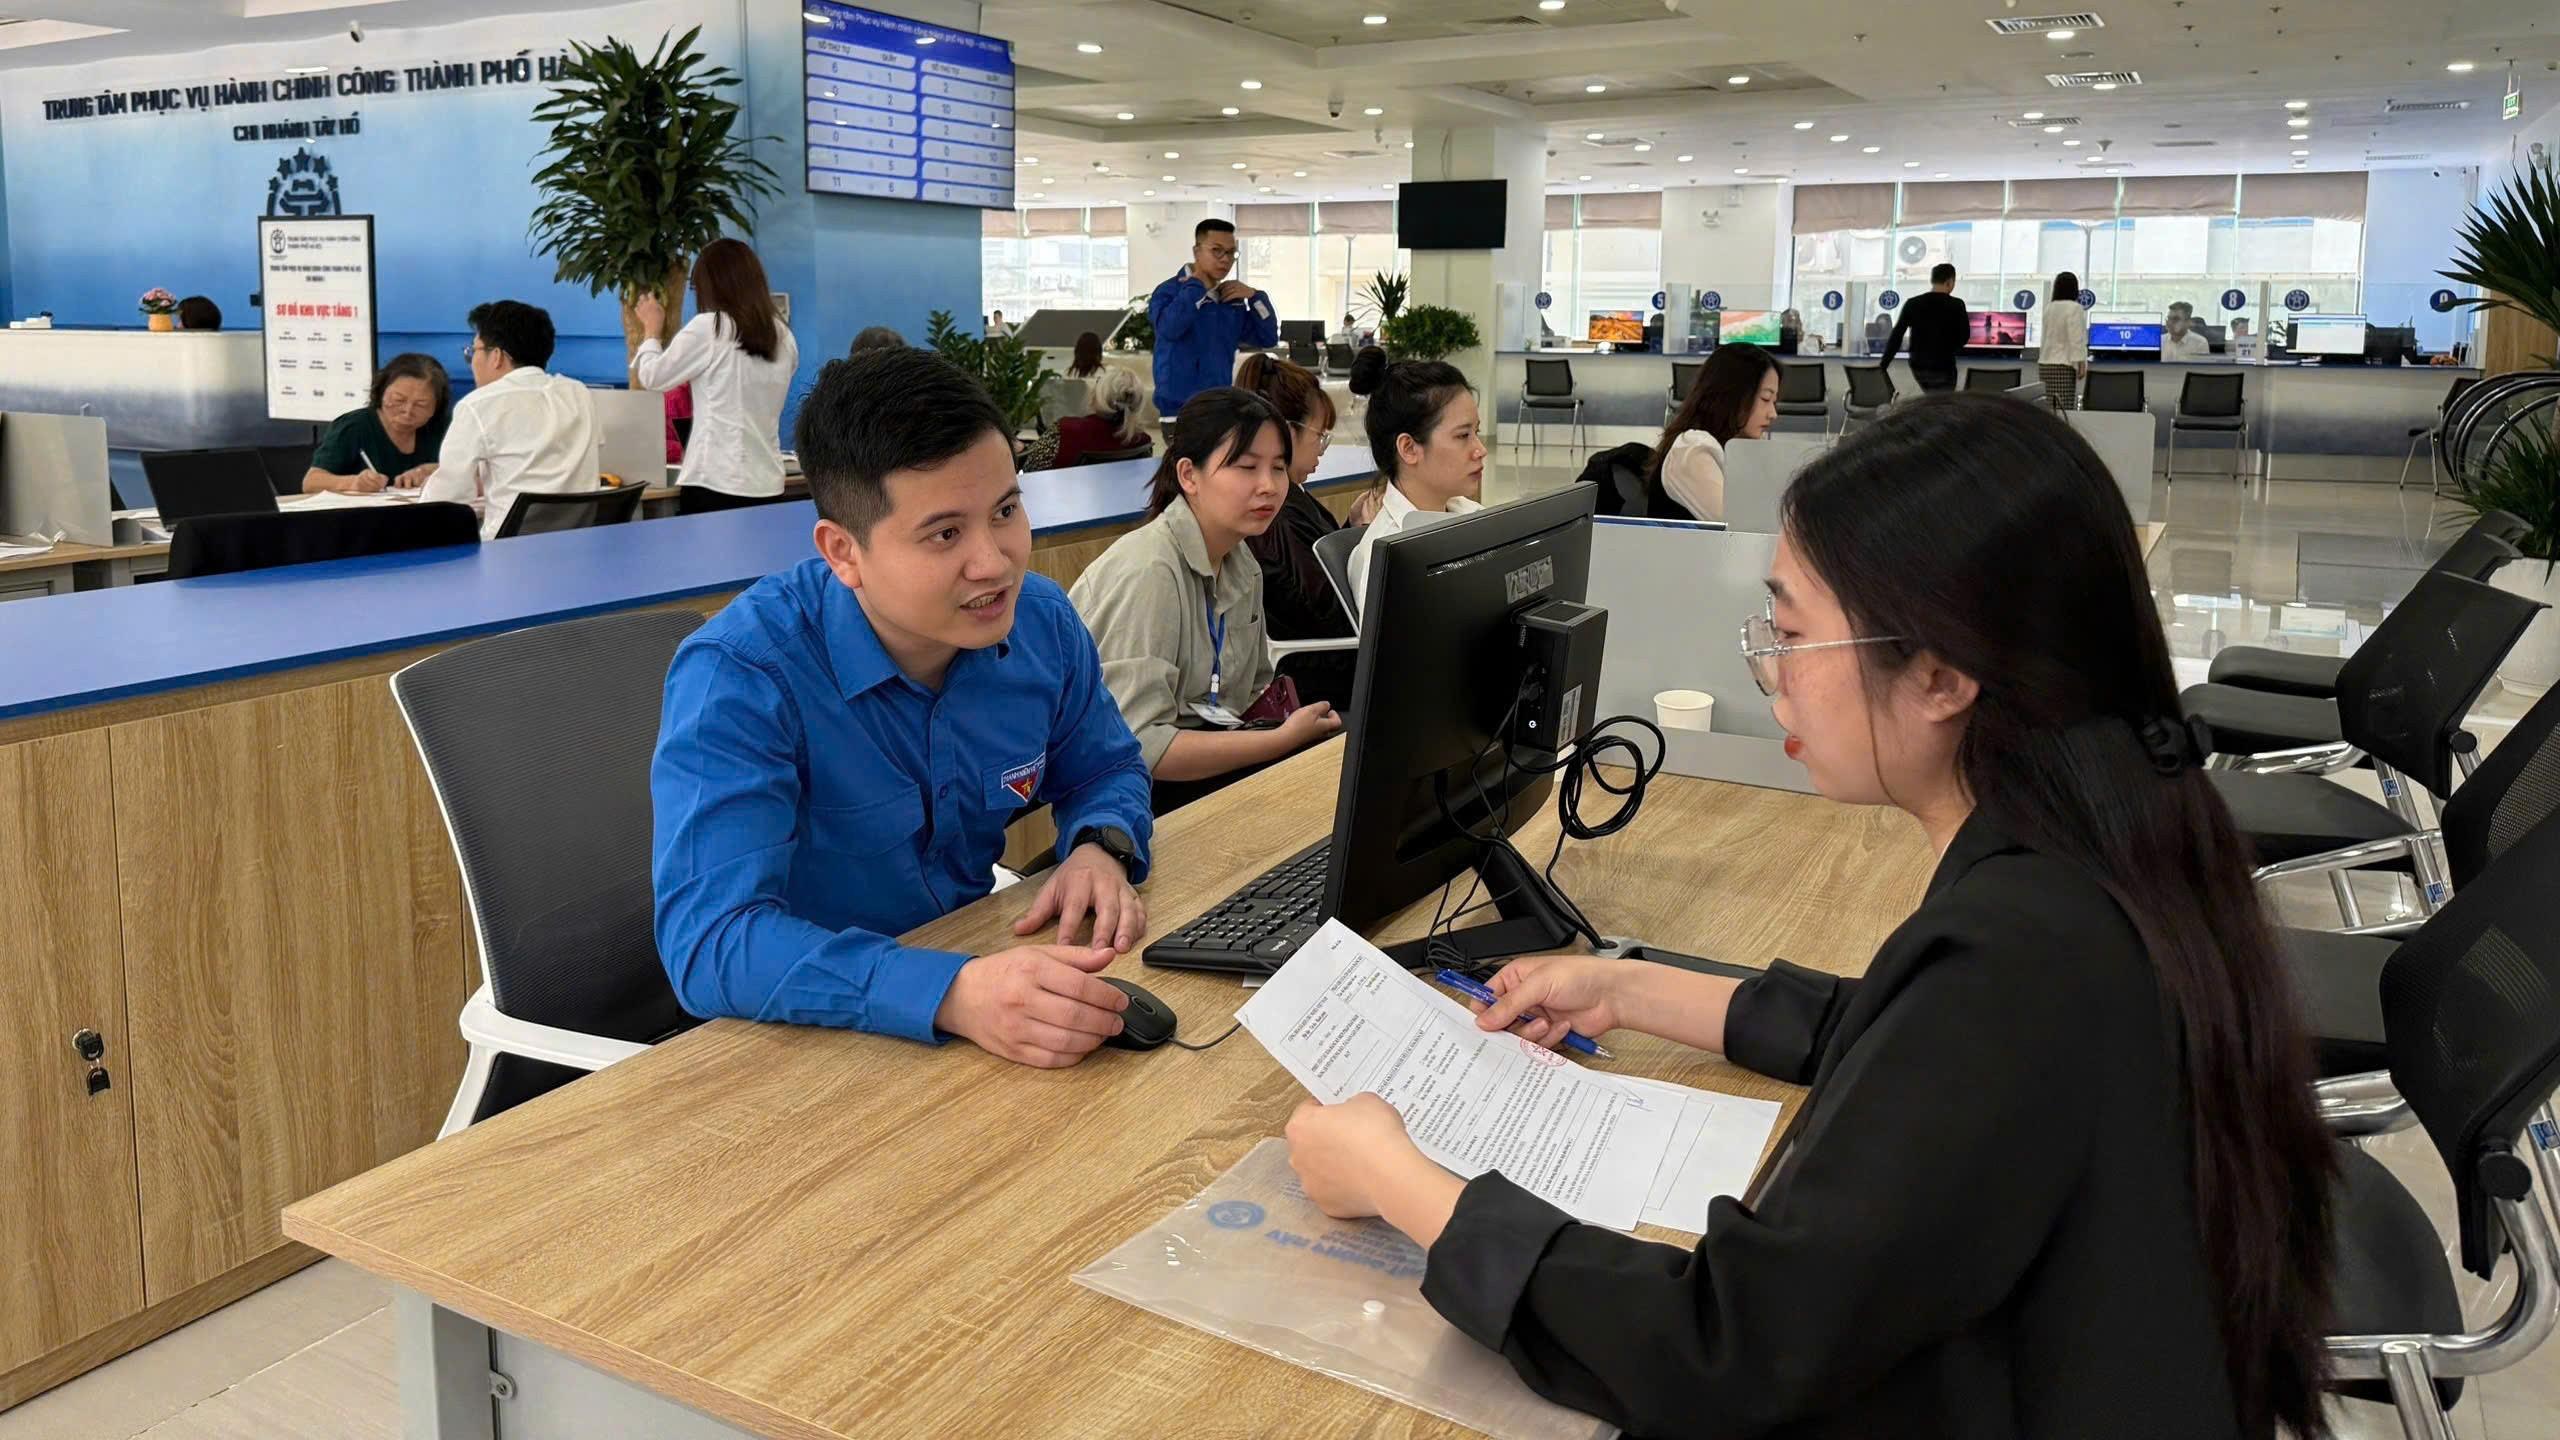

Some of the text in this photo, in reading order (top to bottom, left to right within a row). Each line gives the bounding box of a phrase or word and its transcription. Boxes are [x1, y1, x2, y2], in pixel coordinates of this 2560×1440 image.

[43, 97, 93, 120] TRUNG
[94, 89, 127, 116] TÂM
[131, 88, 181, 115] PHỤC
[186, 86, 209, 112] VỤ
[214, 77, 267, 106] HÀNH
[273, 73, 330, 101] CHÍNH
[337, 67, 395, 96] CÔNG
[404, 60, 474, 92] THÀNH
[481, 49, 530, 85] PHỐ
[234, 125, 259, 141] CHI
[1656, 292, 1665, 308] 5
[2020, 293, 2029, 308] 7
[2228, 291, 2238, 308] 8
[2119, 330, 2131, 340] 10
